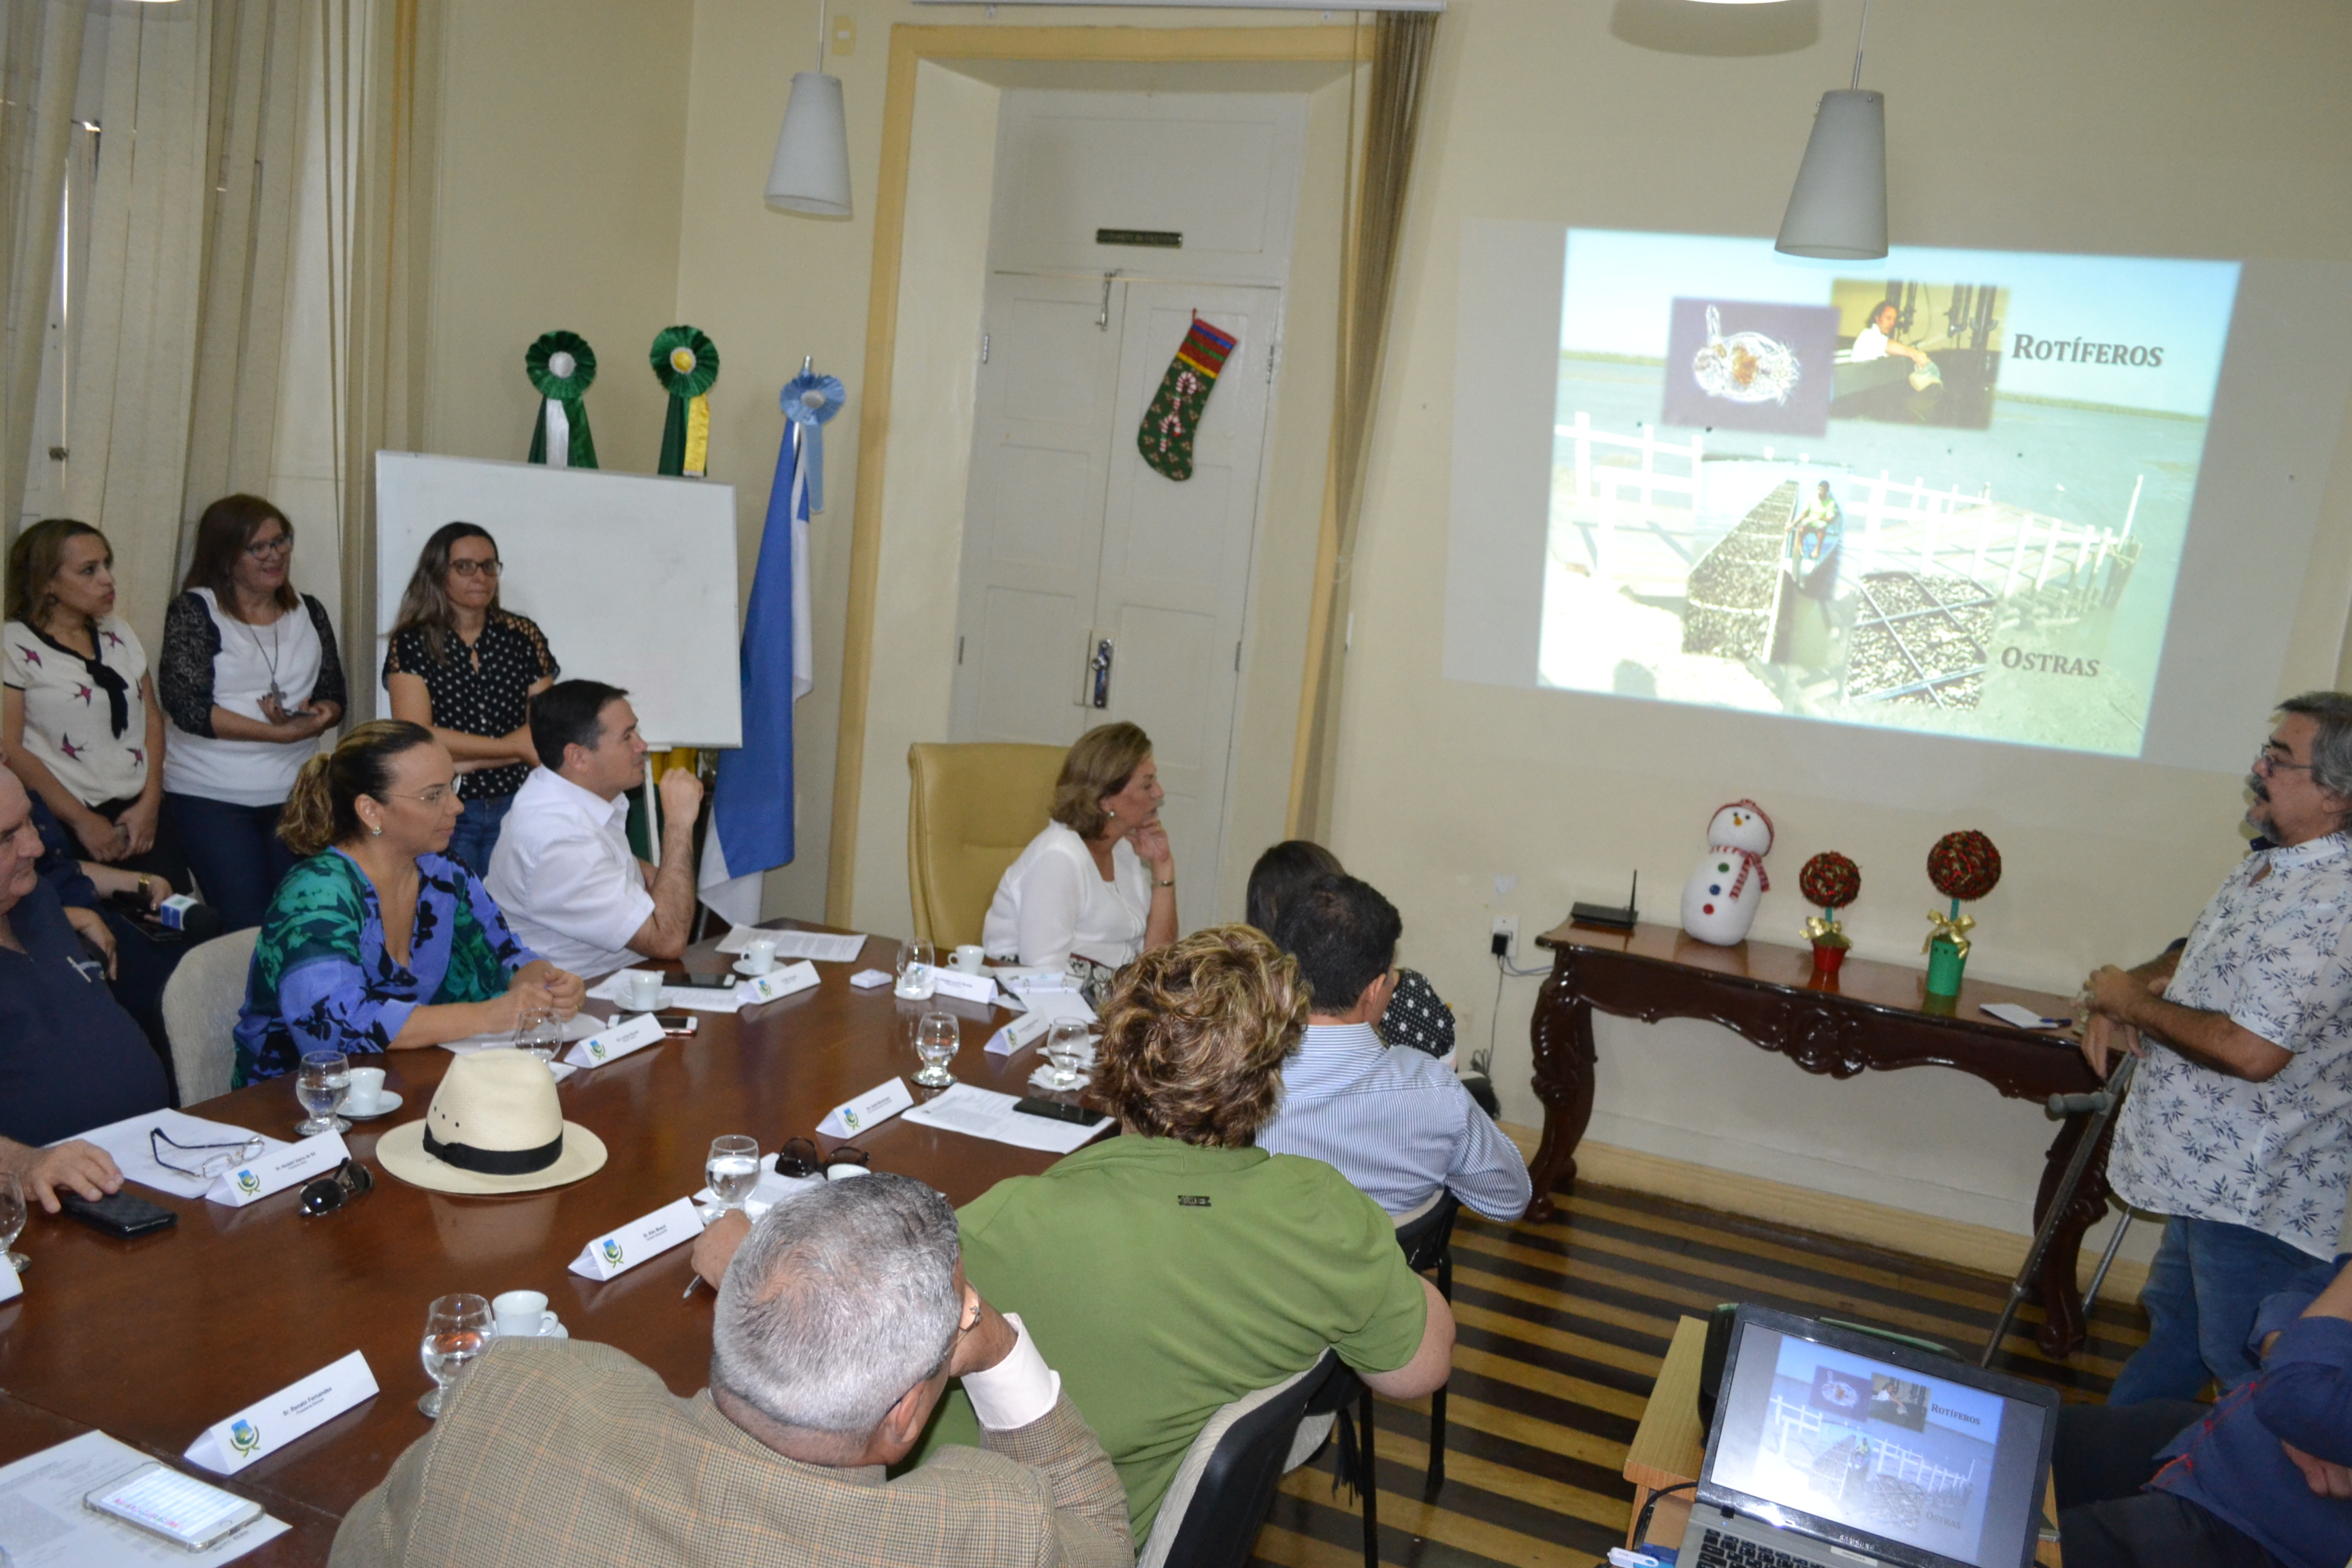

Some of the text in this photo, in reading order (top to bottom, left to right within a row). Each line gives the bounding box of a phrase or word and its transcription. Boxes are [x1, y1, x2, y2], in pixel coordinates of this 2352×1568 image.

[2012, 333, 2163, 368] ROTÍFEROS
[2001, 646, 2100, 677] OSTRAS
[290, 1400, 308, 1412] Renato
[308, 1386, 332, 1403] Fernandes
[1931, 1403, 1981, 1425] ROTÍFEROS
[1925, 1511, 1961, 1530] OSTRAS
[1839, 1535, 1875, 1551] SAMSUNG
